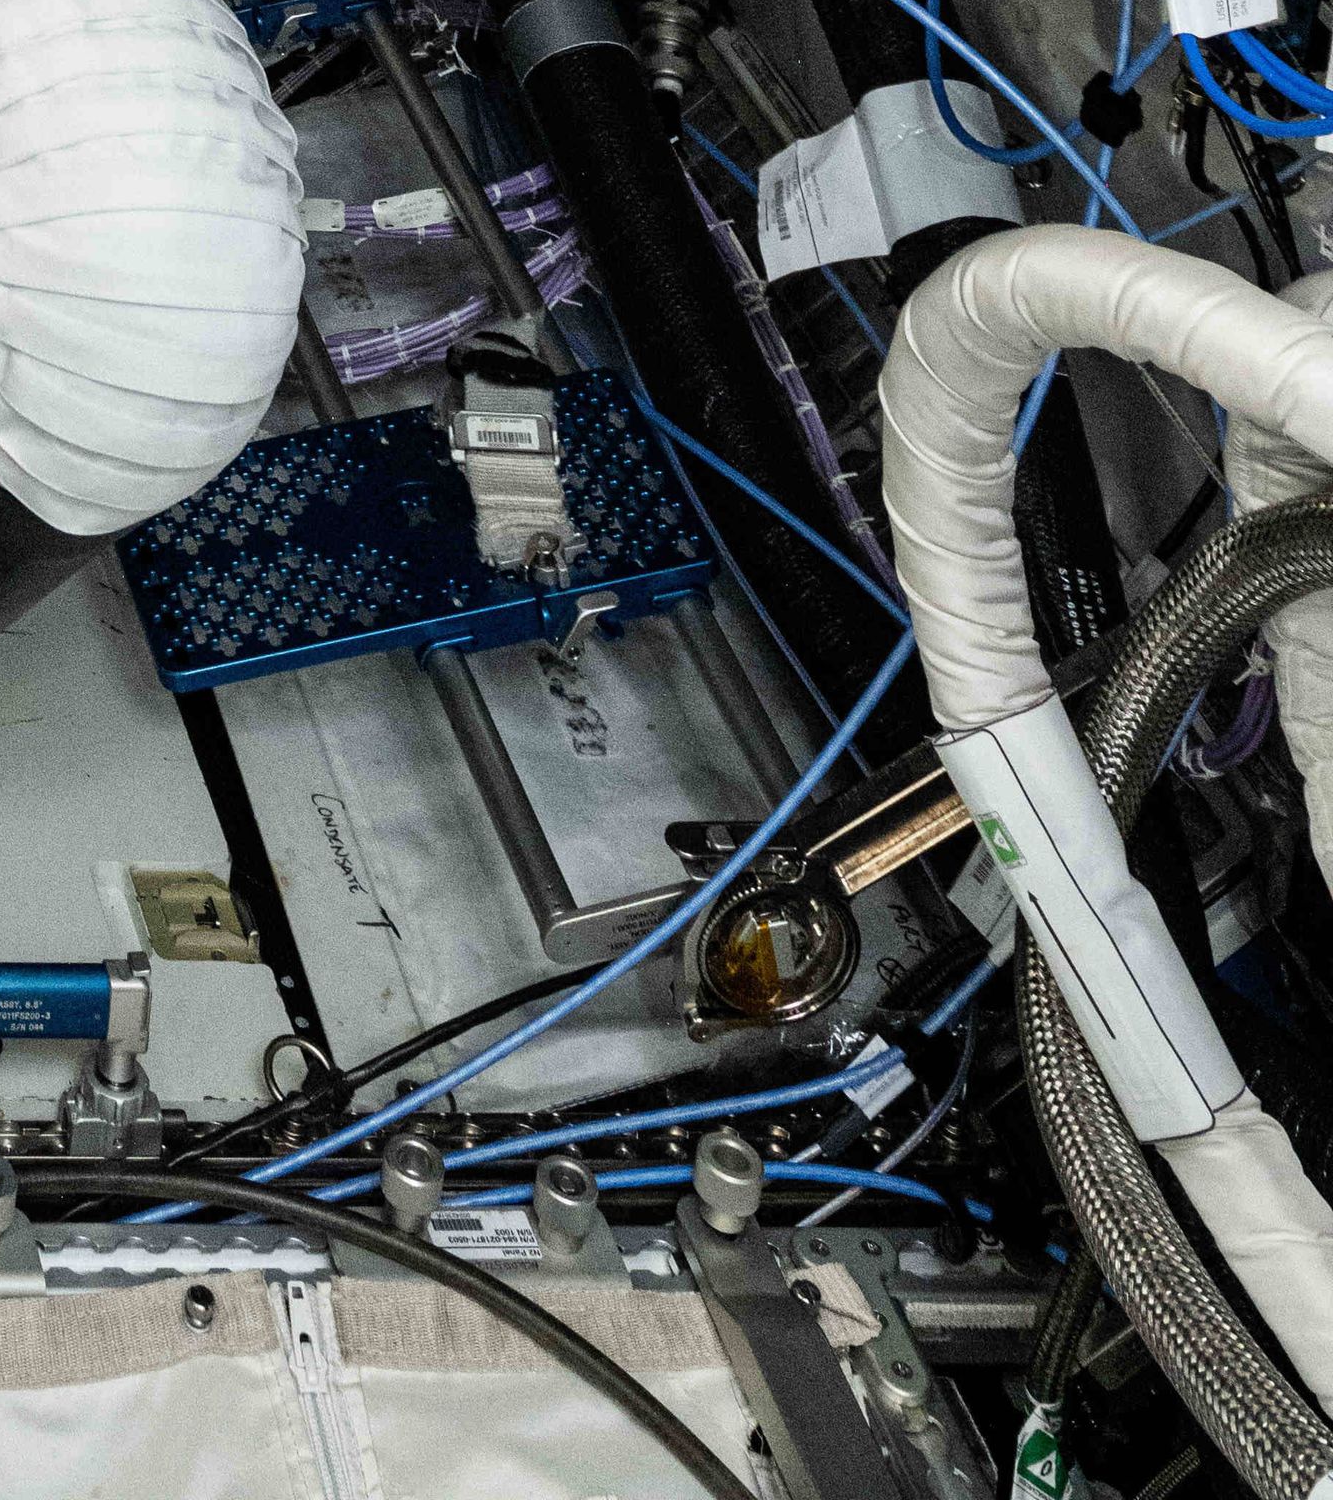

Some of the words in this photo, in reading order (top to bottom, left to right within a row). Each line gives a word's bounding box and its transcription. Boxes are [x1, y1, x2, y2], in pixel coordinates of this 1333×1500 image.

[516, 1228, 532, 1236] S/N
[519, 1235, 534, 1243] P/N
[502, 1248, 526, 1256] Panel
